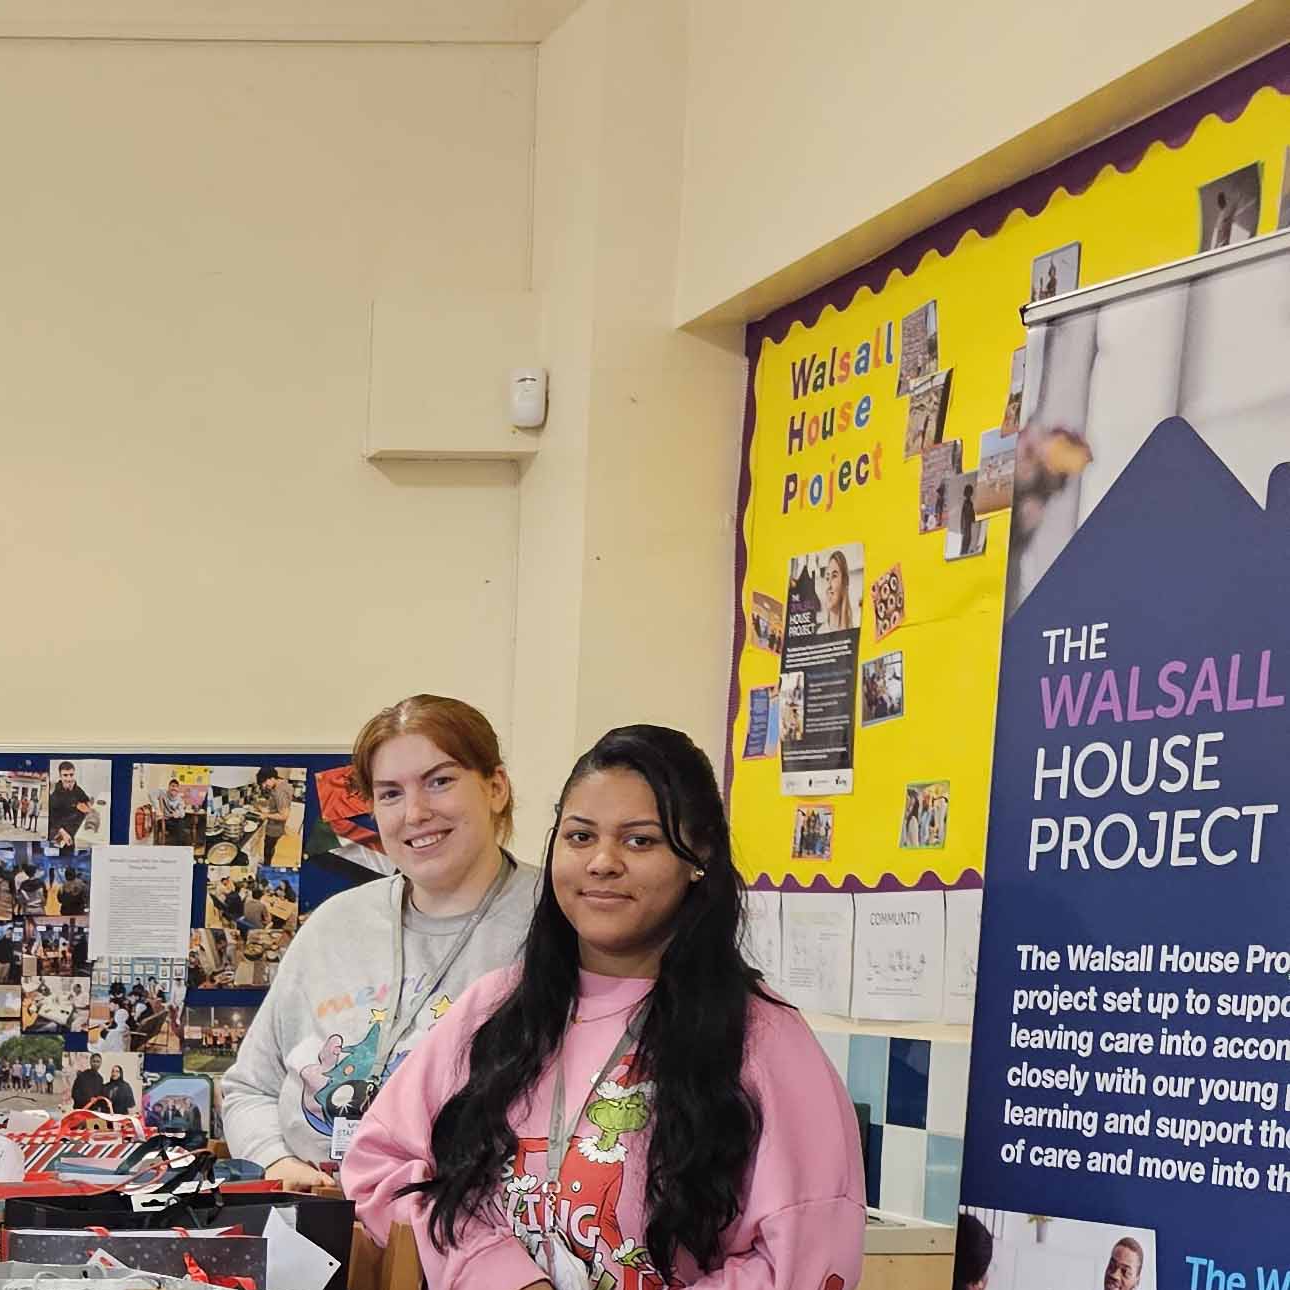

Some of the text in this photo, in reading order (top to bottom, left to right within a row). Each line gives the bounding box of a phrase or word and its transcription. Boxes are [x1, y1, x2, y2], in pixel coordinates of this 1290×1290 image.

[790, 321, 894, 401] Walsall
[787, 394, 871, 456] House
[781, 440, 883, 514] Project
[1043, 623, 1109, 664] THE
[1040, 650, 1285, 729] WALSALL
[1034, 732, 1224, 800] HOUSE
[1028, 804, 1279, 871] PROJECT
[870, 911, 922, 926] COMMUNITY
[1017, 944, 1290, 980] The Walsall House Pro
[1013, 984, 1097, 1015] project
[1102, 987, 1142, 1013] set
[1148, 994, 1179, 1019] up
[1185, 988, 1210, 1015] to
[1010, 1022, 1094, 1057] leaving
[1099, 1030, 1154, 1054] care
[1160, 1028, 1206, 1057] into
[1007, 1062, 1089, 1097] closely
[1095, 1066, 1146, 1095] with
[1152, 1075, 1194, 1098] our
[1198, 1077, 1279, 1112] young
[1003, 1098, 1098, 1137] learning
[1104, 1110, 1151, 1136] and
[1155, 1115, 1253, 1148] support
[1000, 1138, 1026, 1163] of
[1029, 1146, 1081, 1170] care
[1087, 1148, 1133, 1175] and
[1138, 1156, 1205, 1184] move
[1211, 1158, 1260, 1190] into
